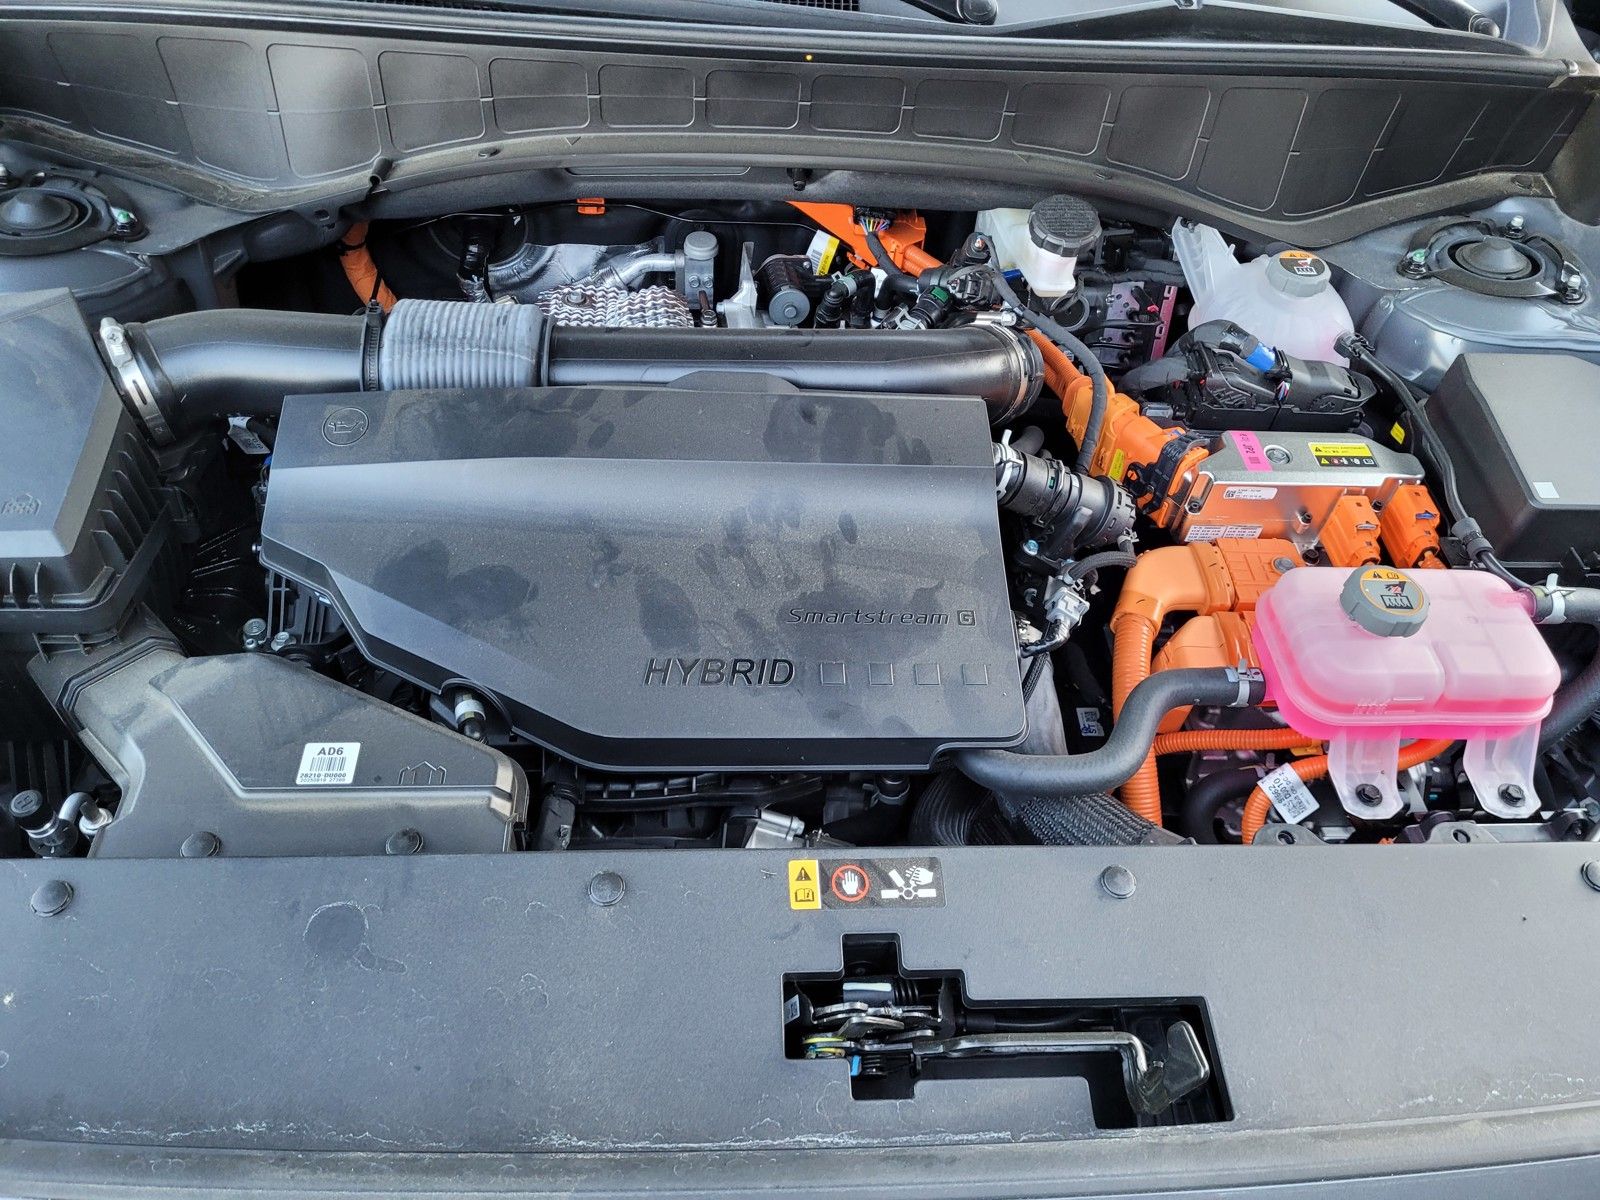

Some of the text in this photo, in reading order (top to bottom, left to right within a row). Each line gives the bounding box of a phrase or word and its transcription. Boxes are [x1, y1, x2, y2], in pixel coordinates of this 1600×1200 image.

[786, 608, 976, 626] Smartstream G
[643, 658, 796, 686] HYBRID
[317, 746, 344, 756] AD6
